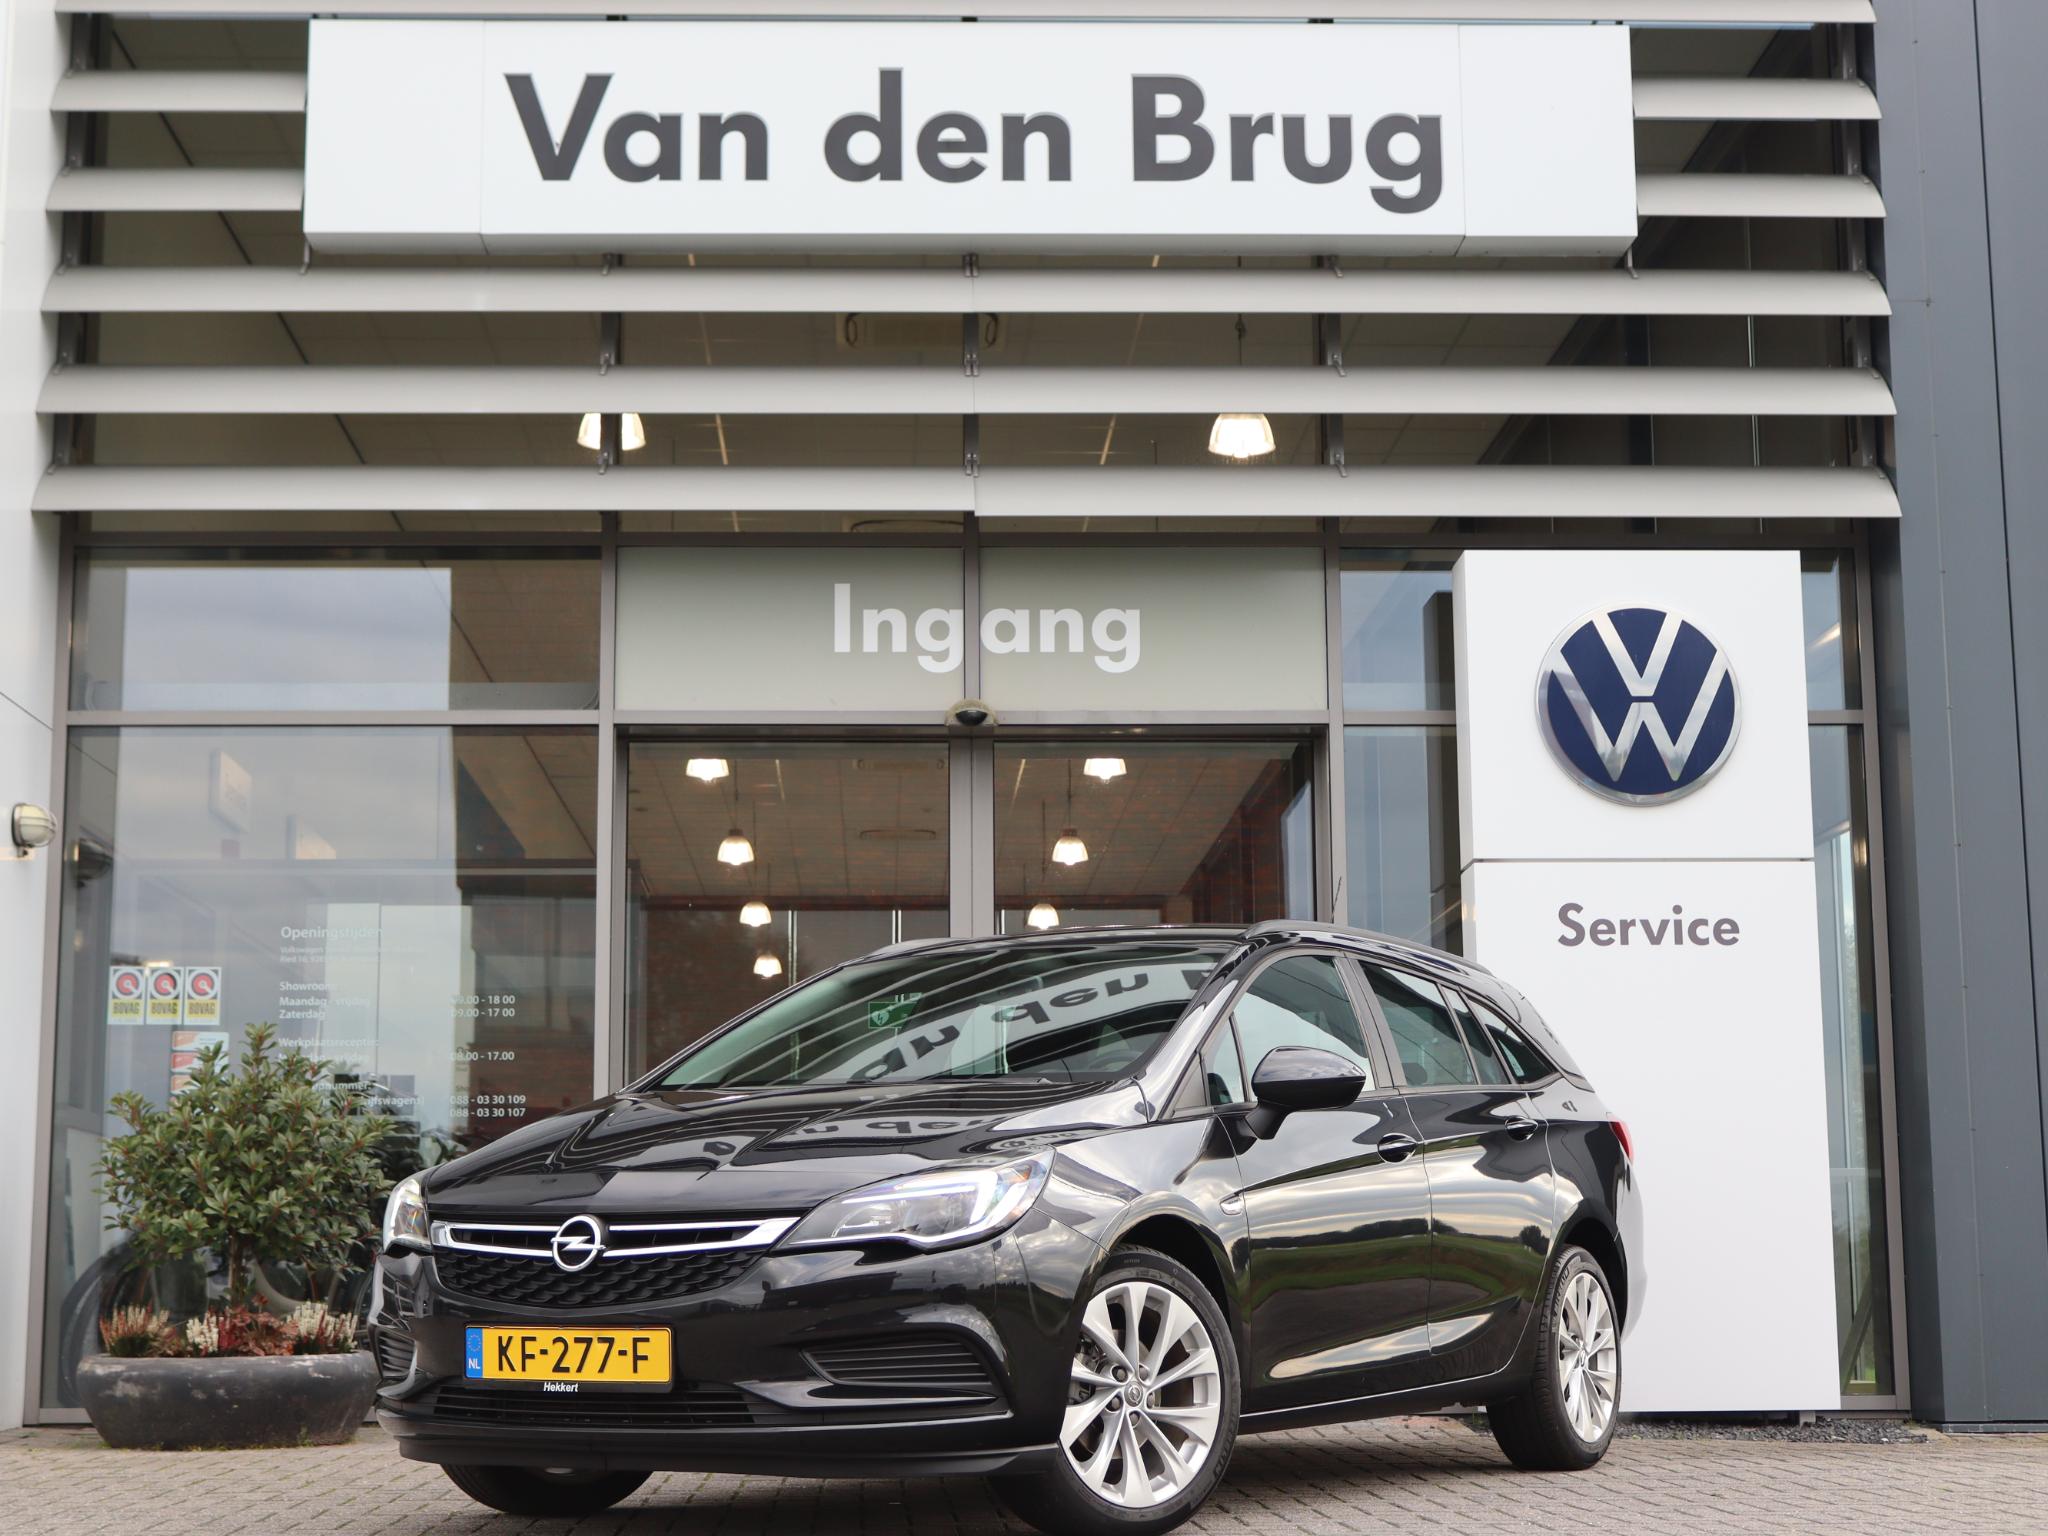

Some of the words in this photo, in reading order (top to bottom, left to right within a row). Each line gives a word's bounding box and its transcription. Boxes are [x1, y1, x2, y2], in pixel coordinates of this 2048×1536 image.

[503, 72, 769, 184] Van
[823, 66, 1072, 184] den
[1131, 72, 1443, 214] Brug
[833, 582, 1141, 674] Ingang
[1557, 902, 1741, 948] Service
[278, 996, 328, 1008] Maandag
[278, 1009, 328, 1020] Zaterdag
[487, 1051, 515, 1061] 17.00
[449, 1095, 469, 1105] 088
[477, 1095, 490, 1105] 03
[491, 1095, 505, 1105] 30
[507, 1095, 526, 1105] 109
[477, 1107, 490, 1118] 03
[491, 1107, 505, 1118] 30
[507, 1107, 526, 1118] 107
[497, 1335, 651, 1374] KF-277-F
[468, 1358, 481, 1370] NL
[543, 1381, 579, 1393] Hekkert
